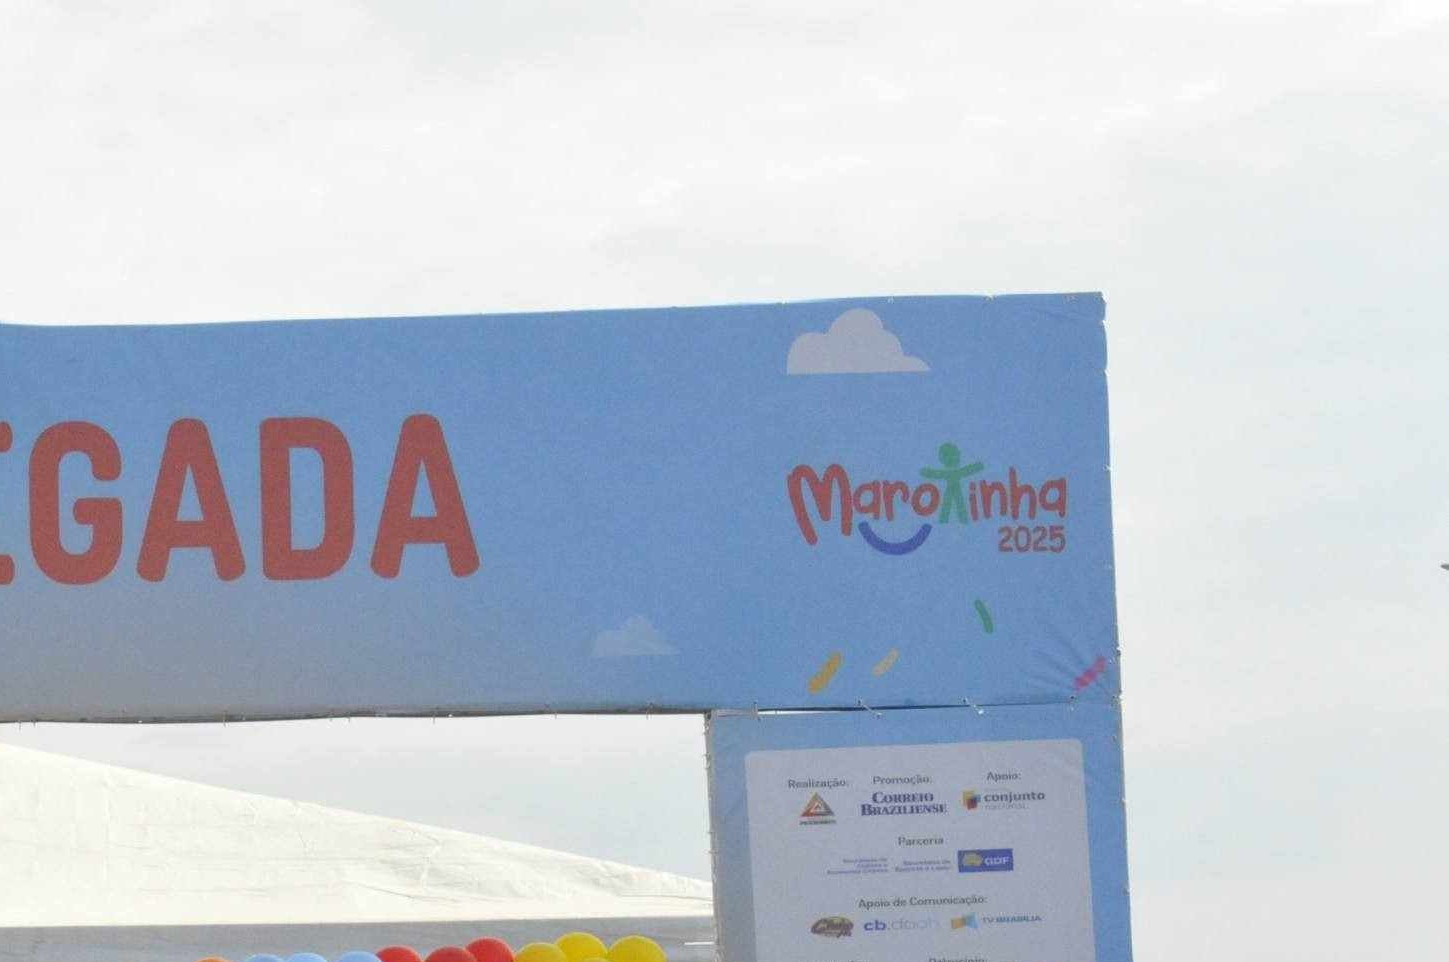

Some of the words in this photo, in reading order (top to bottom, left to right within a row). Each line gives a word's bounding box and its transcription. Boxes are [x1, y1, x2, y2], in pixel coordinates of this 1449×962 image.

[787, 442, 1067, 546] Marotinha
[998, 525, 1066, 552] 2025
[984, 791, 1046, 803] conjunto
[861, 803, 947, 816] BRAZILIENSE
[893, 899, 906, 907] de
